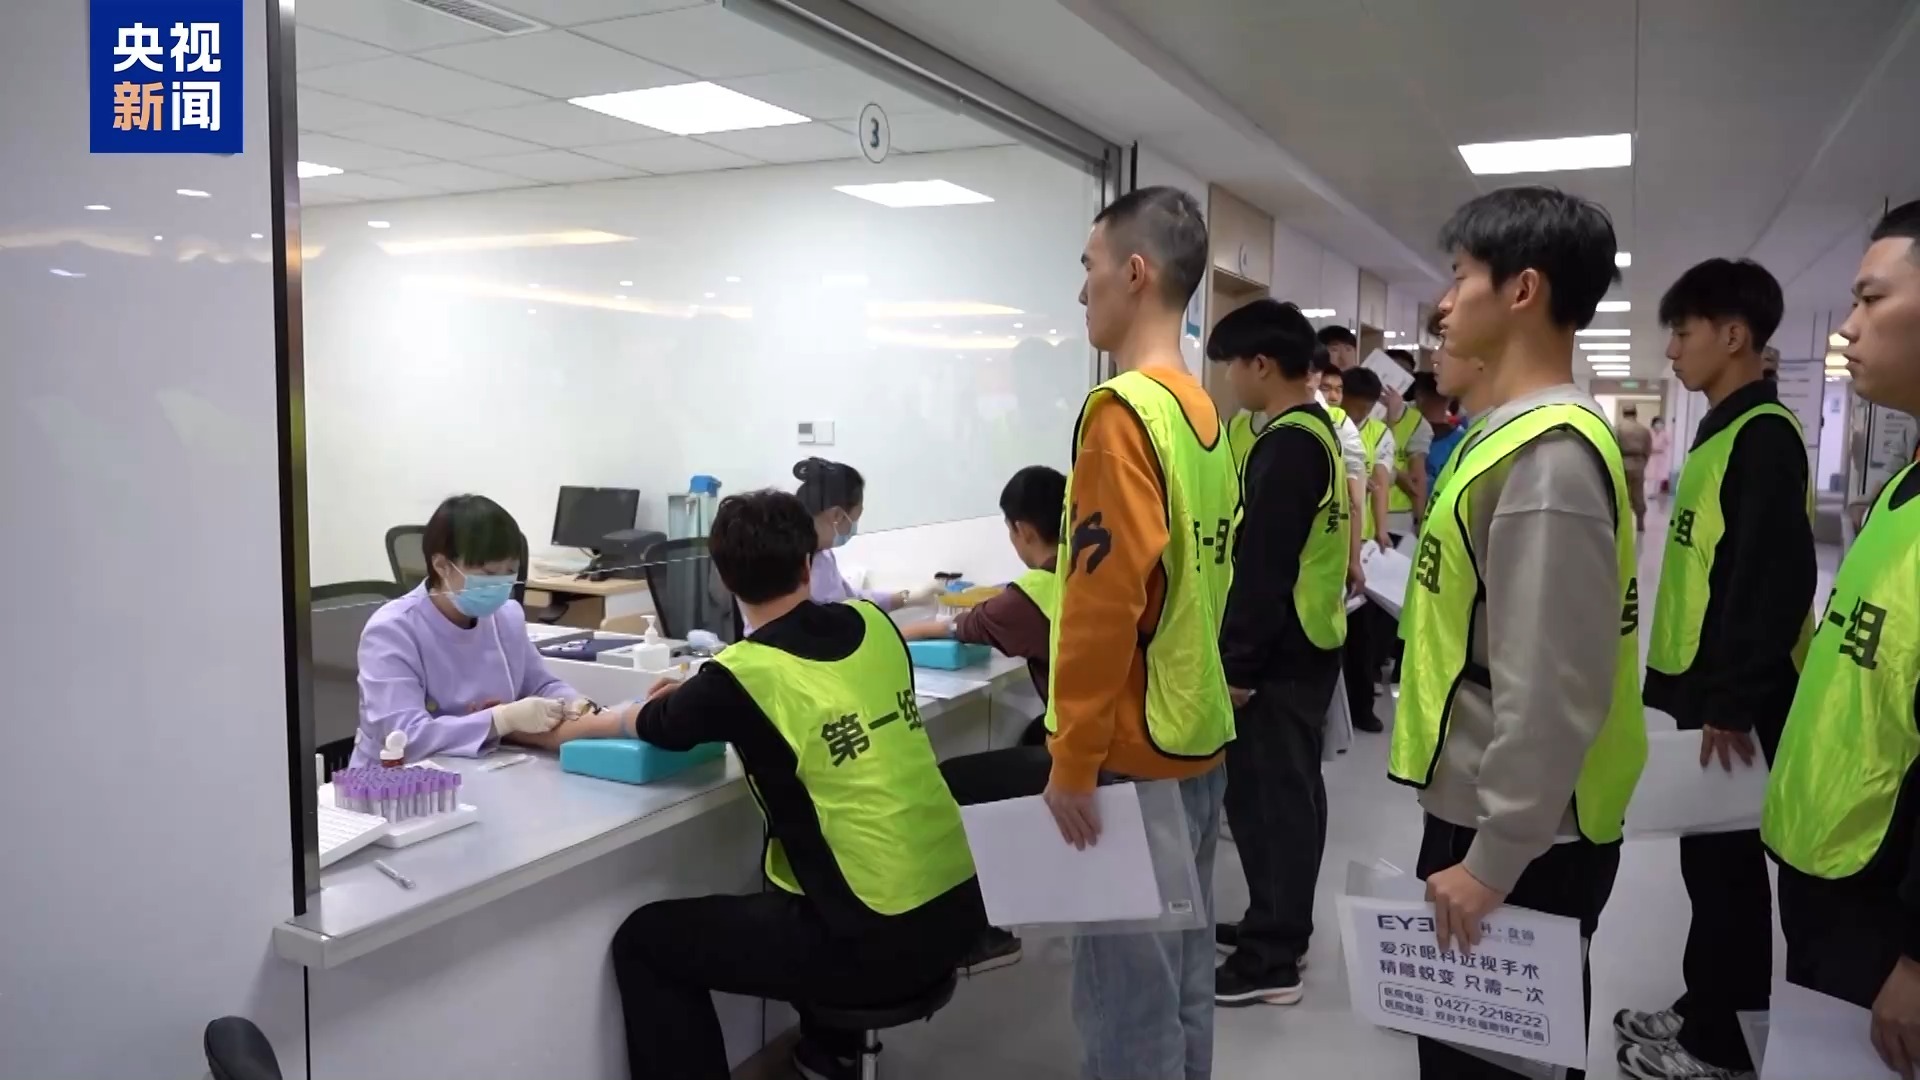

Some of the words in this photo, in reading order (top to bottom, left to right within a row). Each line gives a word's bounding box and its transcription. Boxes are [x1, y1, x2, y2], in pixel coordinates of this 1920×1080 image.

[870, 117, 880, 149] 3
[821, 689, 922, 768] 第一组
[1380, 941, 1540, 980] 爱尔眼科近视手术
[1379, 959, 1455, 988] 精雕蜕变
[1464, 974, 1545, 1006] 只需一次
[1434, 995, 1543, 1028] 0427-2218222
